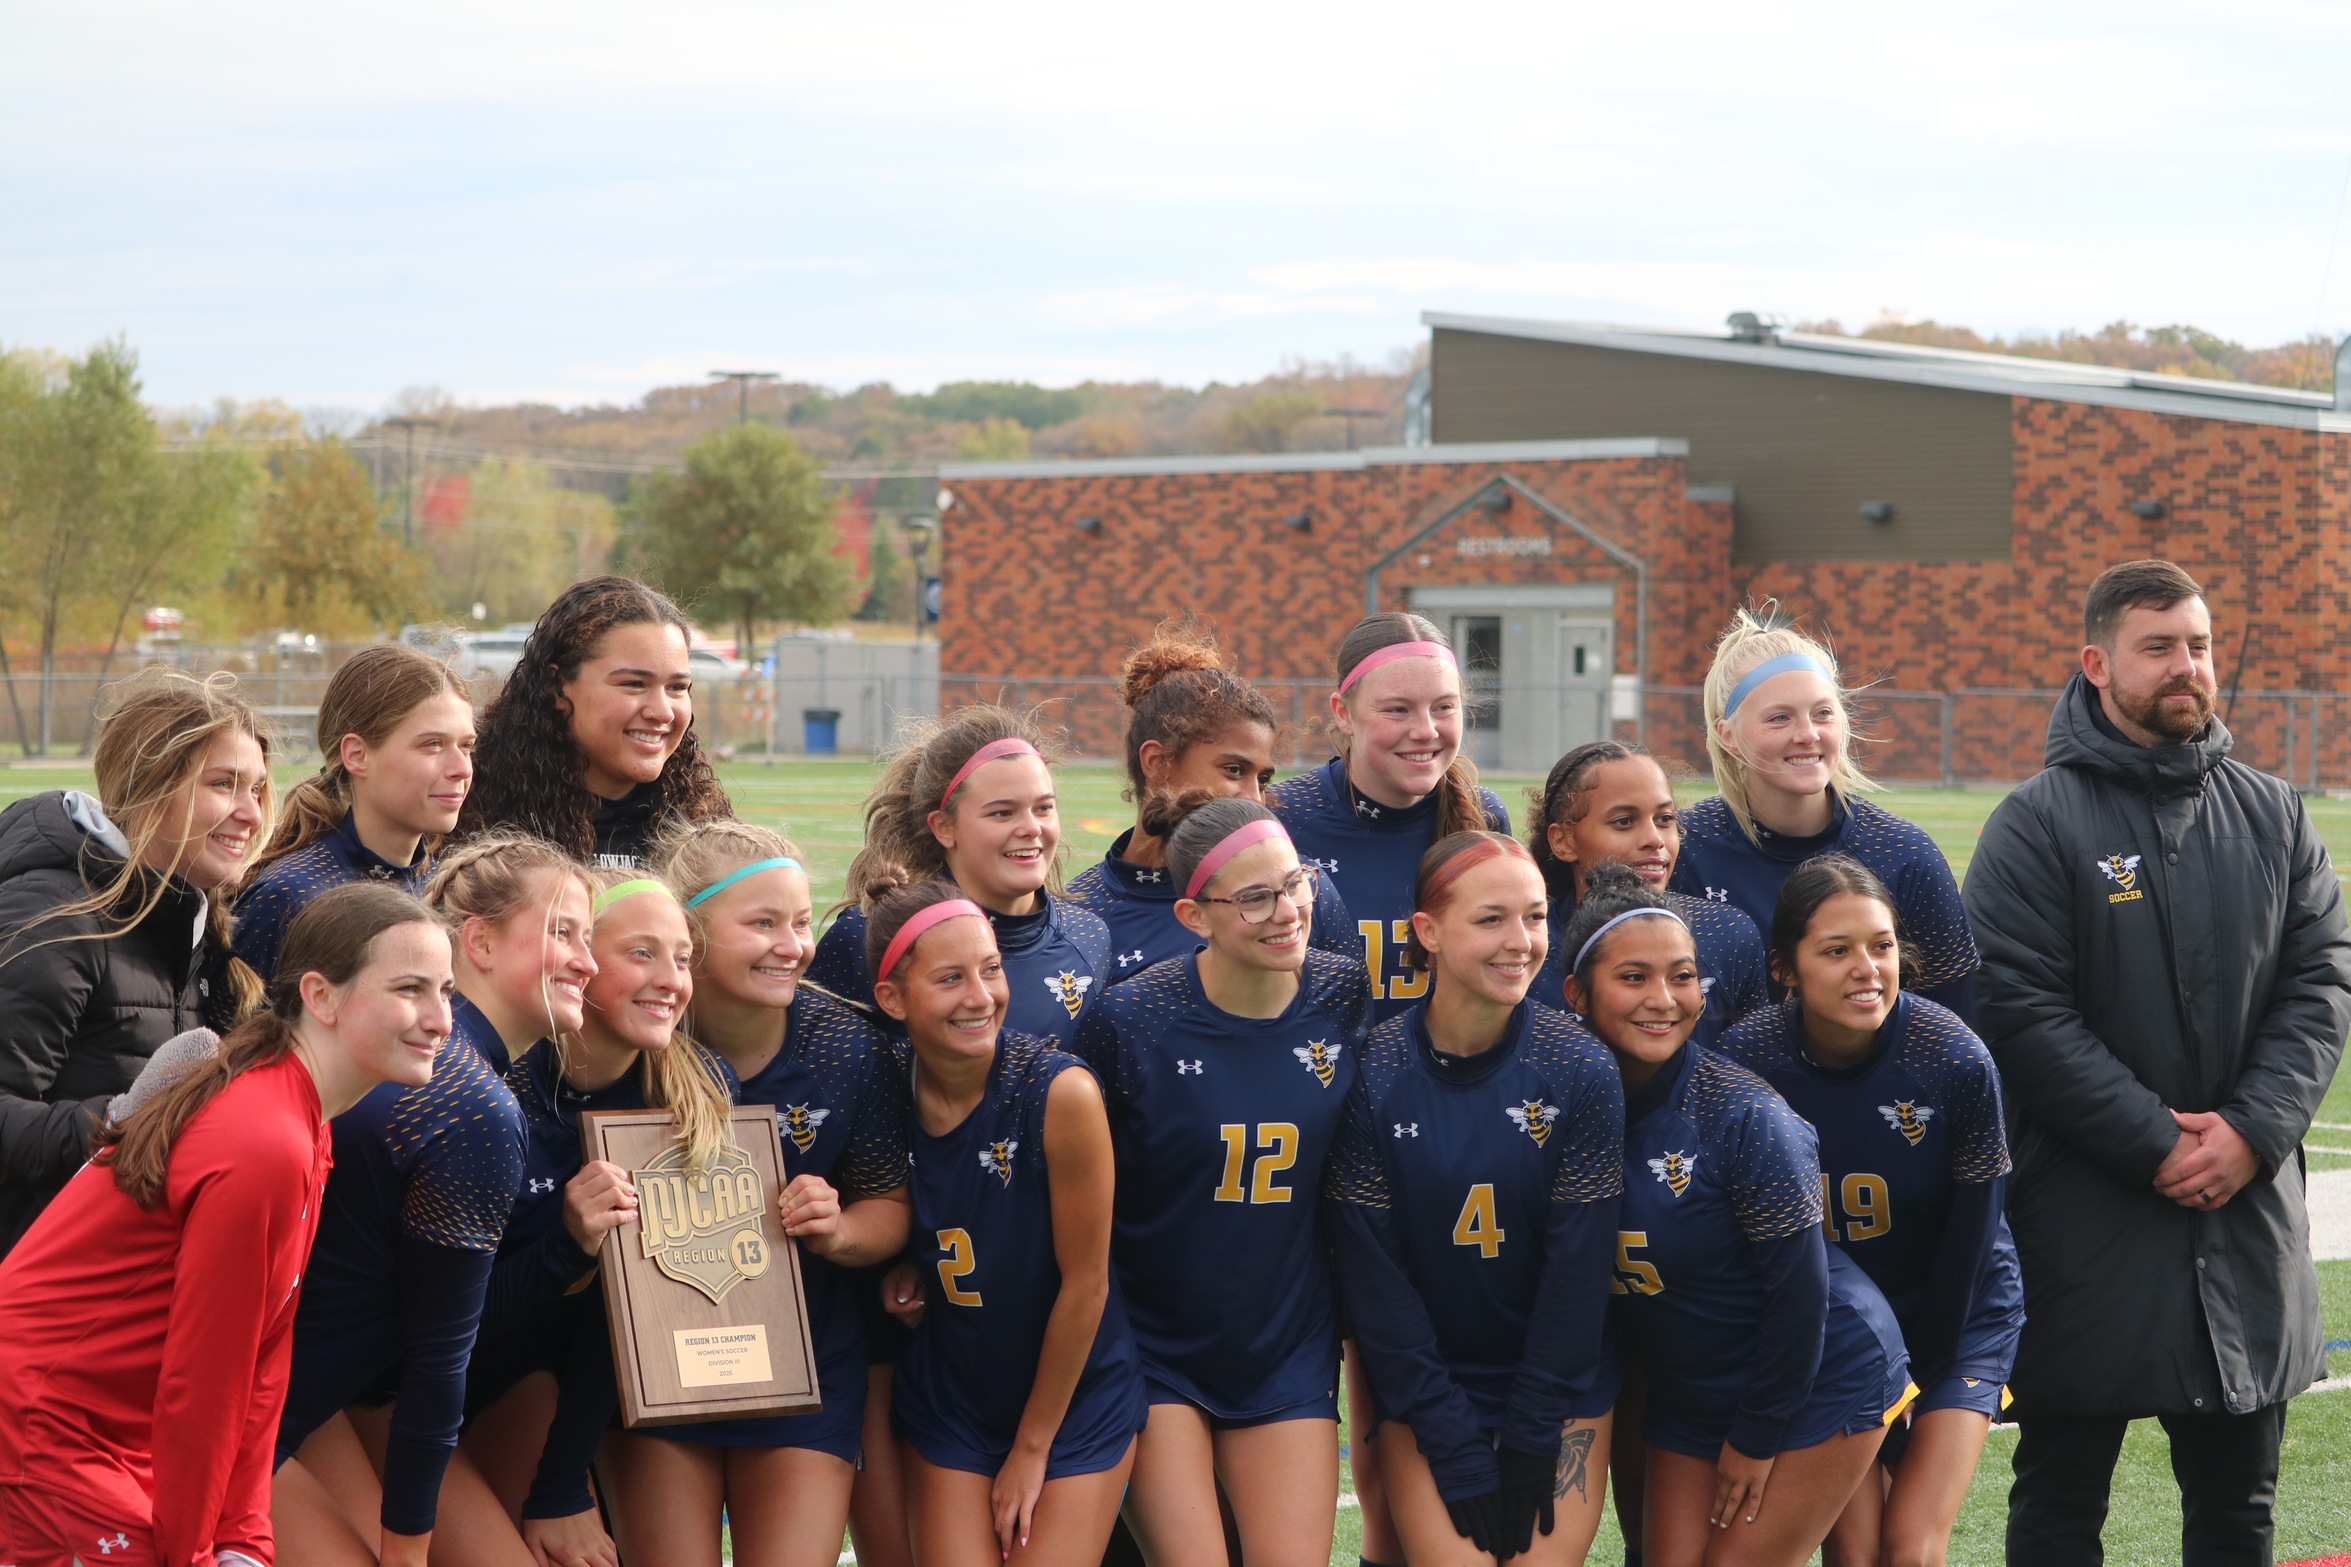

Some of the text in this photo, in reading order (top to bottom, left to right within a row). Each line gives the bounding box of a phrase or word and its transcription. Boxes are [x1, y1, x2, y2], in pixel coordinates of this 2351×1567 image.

[2108, 889, 2144, 904] SOCCER
[1358, 919, 1431, 999] 13
[1213, 1122, 1299, 1204] 12
[640, 1173, 760, 1248] NJCAA
[1452, 1183, 1506, 1259] 4
[673, 1240, 763, 1265] REGION 13
[936, 1227, 984, 1307] 2
[1610, 1230, 1666, 1296] 5
[685, 1334, 756, 1346] REGION 13 CHAMPION
